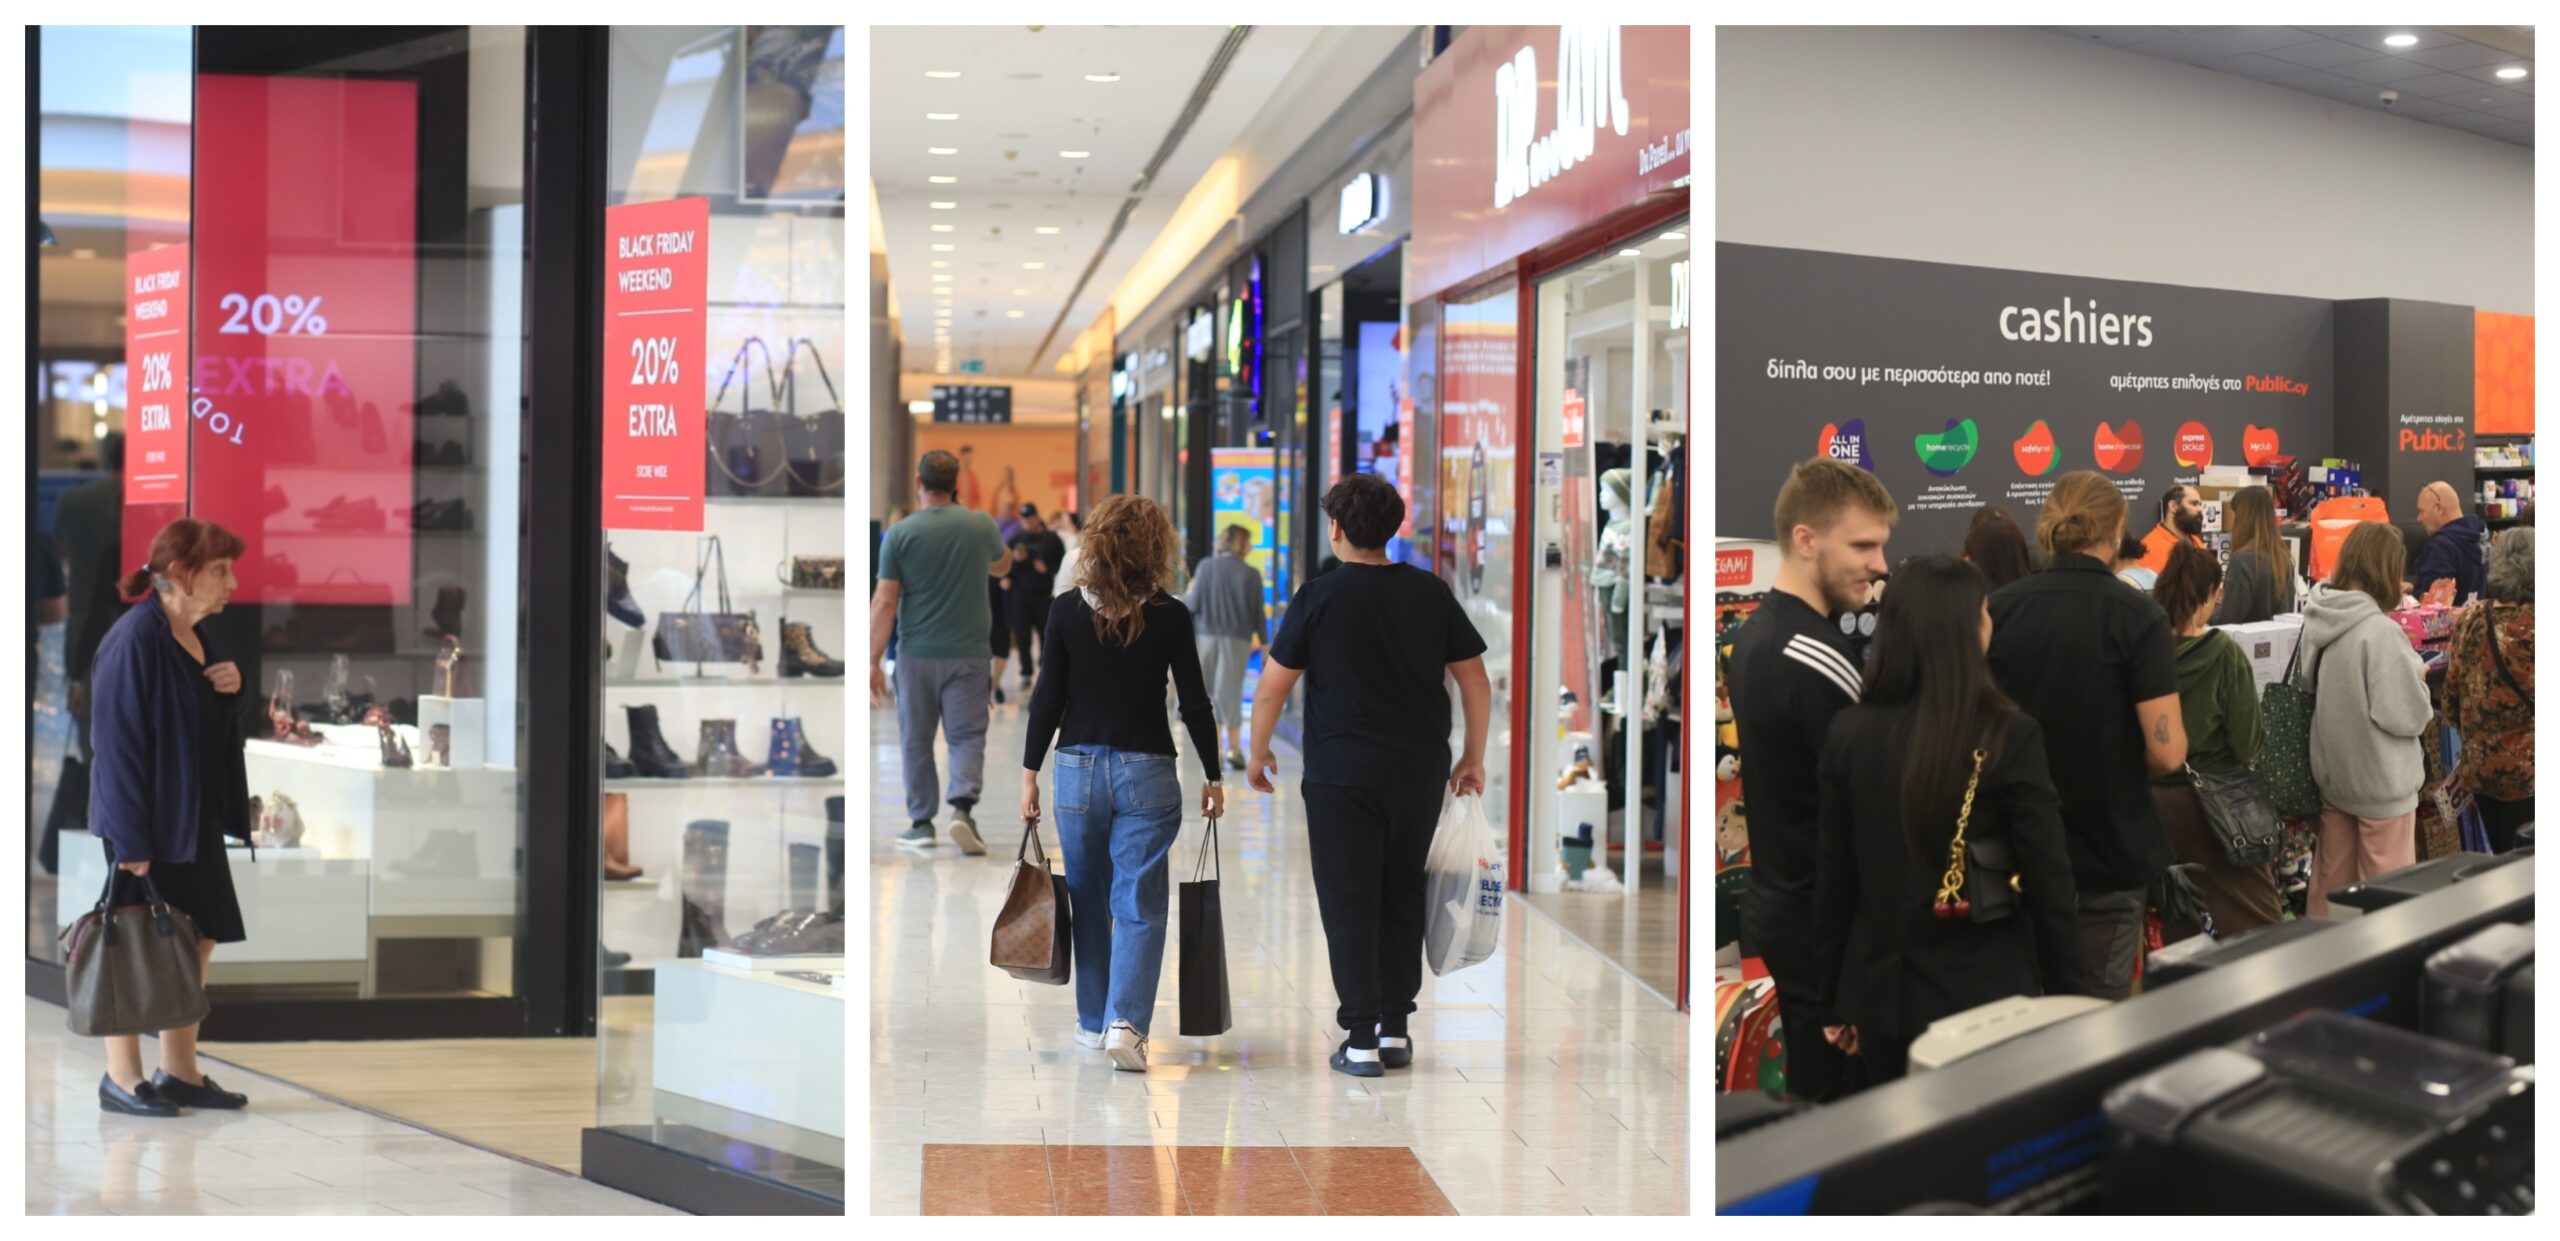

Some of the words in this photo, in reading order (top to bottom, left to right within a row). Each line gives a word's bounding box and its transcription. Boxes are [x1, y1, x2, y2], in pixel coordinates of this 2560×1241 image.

[619, 234, 654, 259] BLACK
[656, 230, 695, 255] FRIDAY
[618, 267, 673, 293] WEEKEND
[219, 293, 328, 337] 20%
[1999, 296, 2153, 347] cashiers
[142, 351, 172, 393] 20%
[631, 336, 680, 385] 20%
[1767, 358, 1818, 379] δίπλα
[1823, 366, 1856, 380] σου
[1861, 367, 1881, 386] με
[1884, 365, 1980, 388] περισσότερα
[1983, 371, 2012, 385] απο
[2015, 369, 2051, 386] ποτέ!
[196, 355, 350, 397] EXTRA
[2110, 372, 2169, 392] αμέτρητες
[2171, 374, 2220, 393] επιλογές
[2222, 378, 2242, 391] στο
[2245, 374, 2309, 396] Public.cy
[141, 403, 171, 433] EXTRA
[629, 403, 678, 437] EXTRA
[1829, 435, 1848, 445] ALL
[1849, 434, 1860, 444] IN
[1829, 444, 1860, 458] ONE
